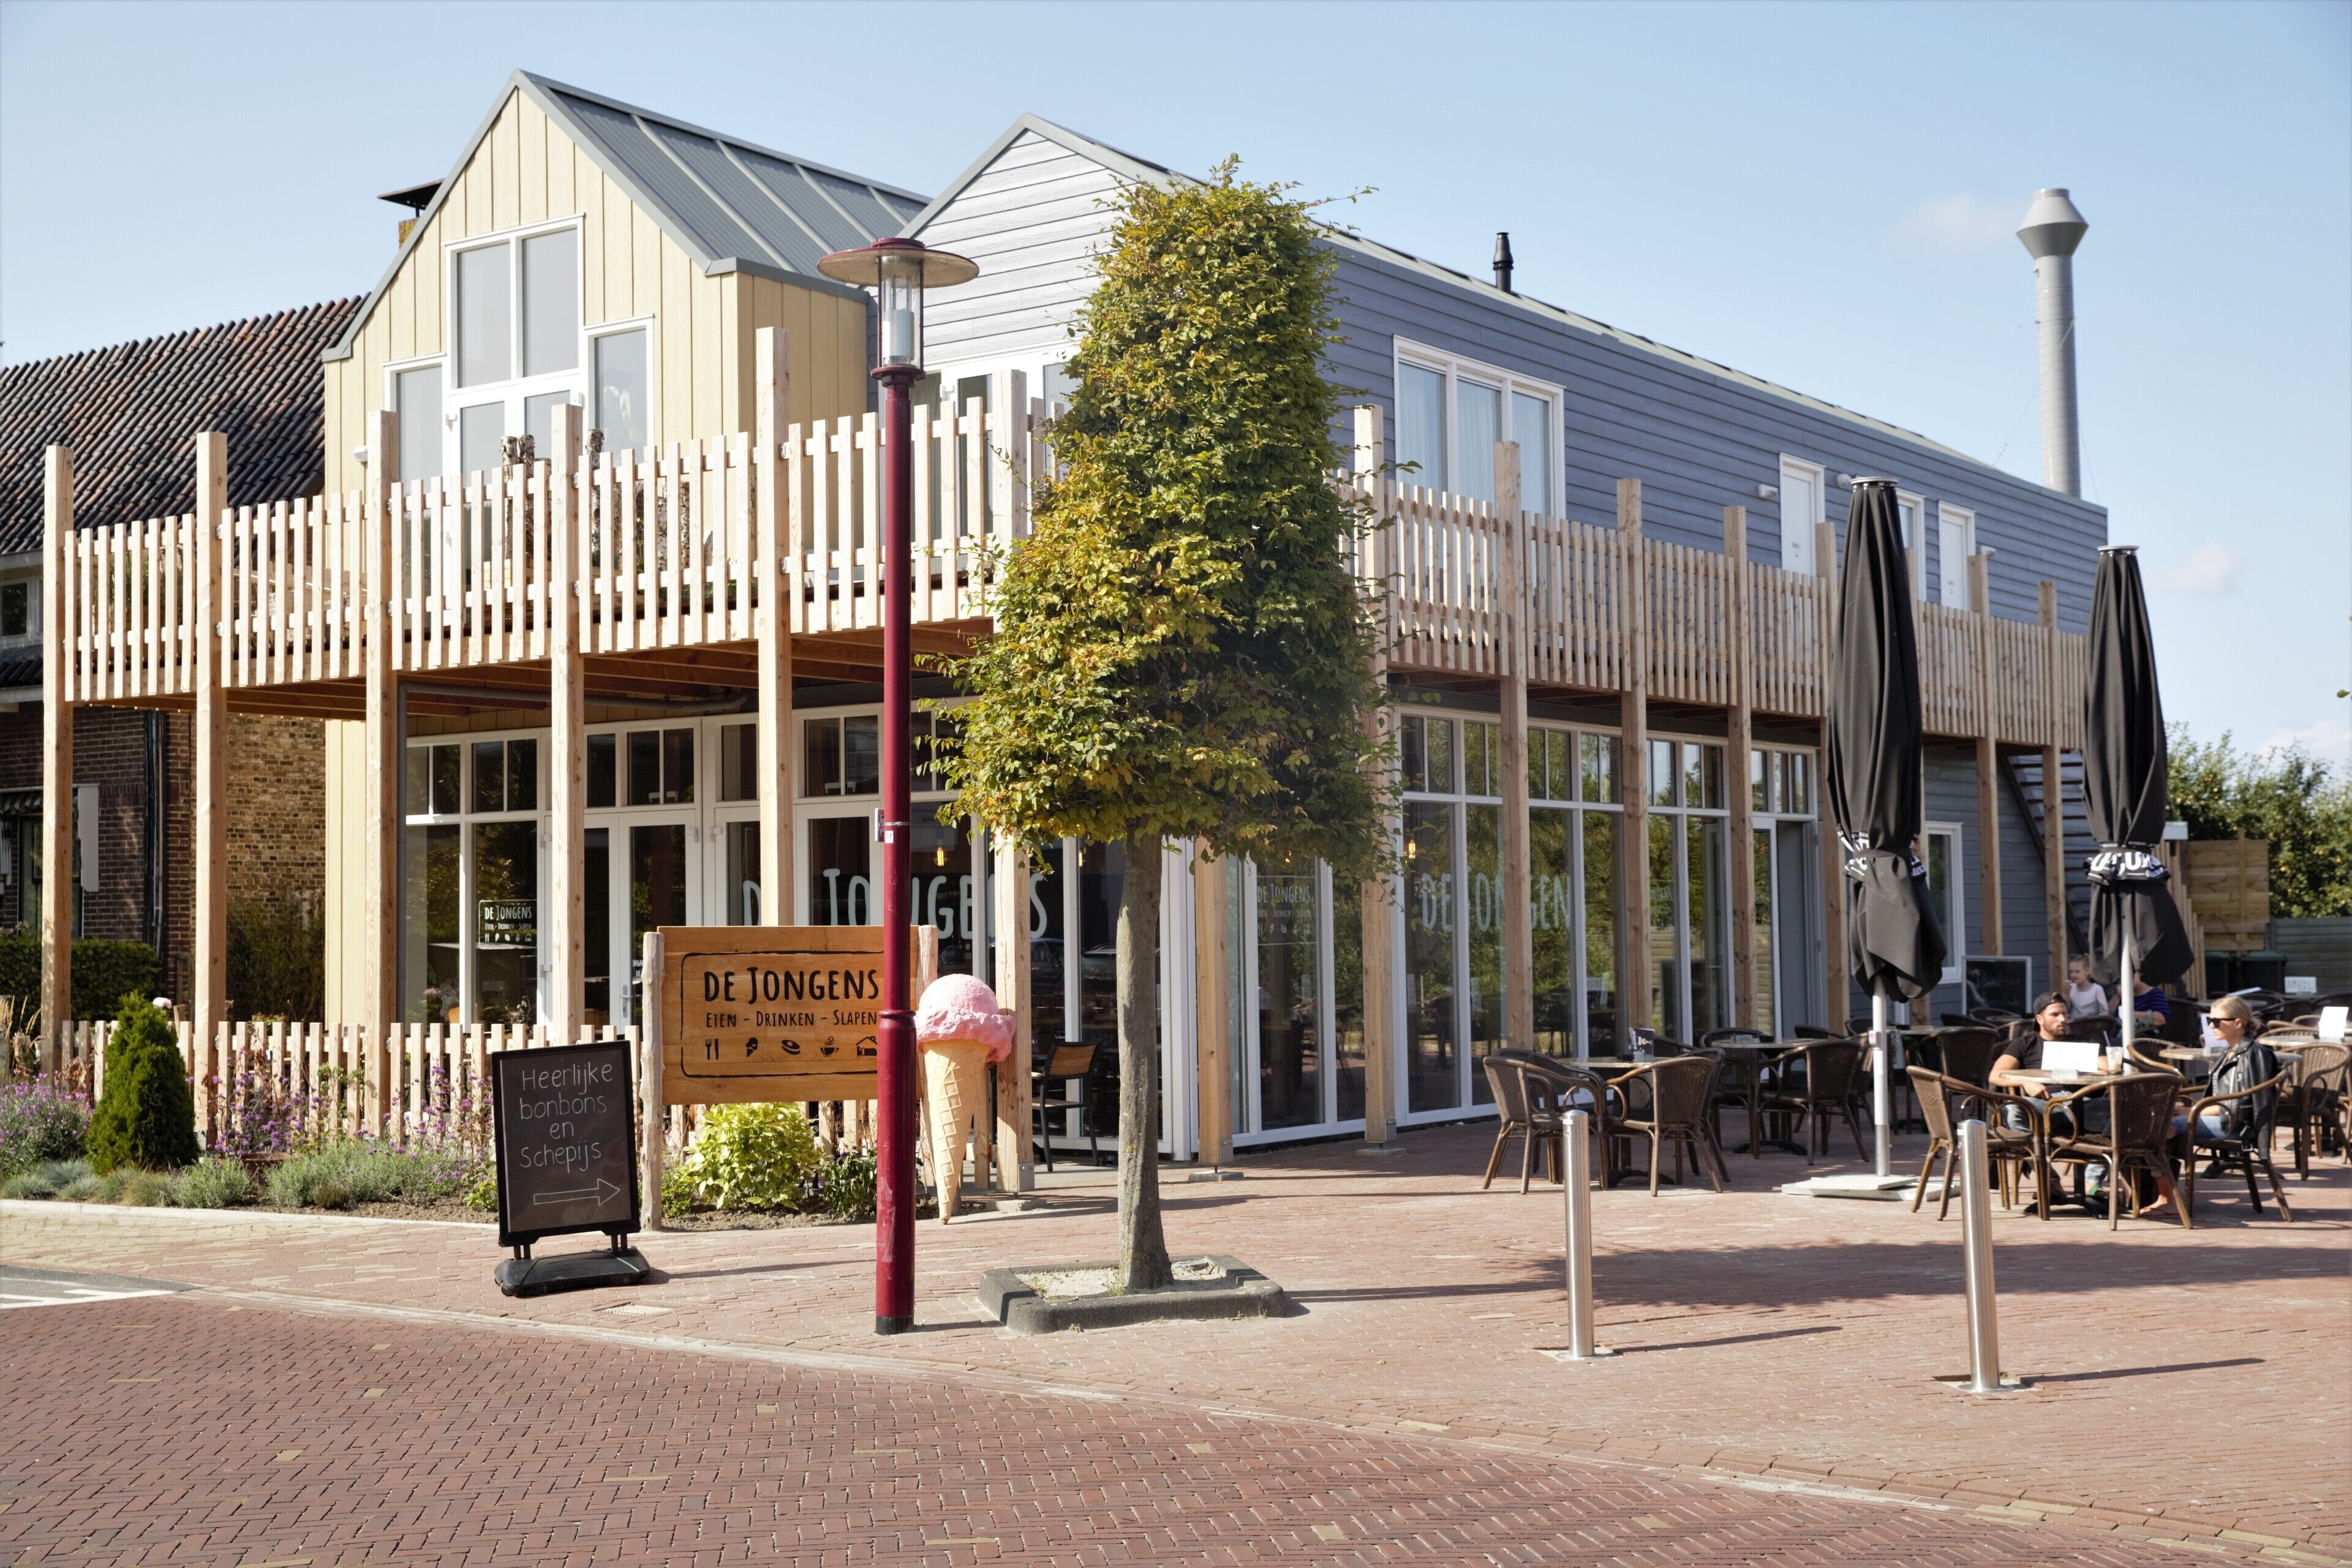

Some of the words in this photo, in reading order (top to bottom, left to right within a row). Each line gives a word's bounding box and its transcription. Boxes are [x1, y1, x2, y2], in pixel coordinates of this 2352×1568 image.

[1257, 886, 1268, 903] DE
[484, 907, 494, 920] DE
[496, 905, 532, 921] JONGENS
[704, 971, 735, 1001] DE
[747, 967, 879, 1005] JONGENS
[706, 1012, 736, 1028] ETEN
[756, 1011, 814, 1027] DRINKEN
[834, 1010, 876, 1026] SLAPEN
[522, 1061, 612, 1095] Heerlijke
[520, 1092, 607, 1120] bonbons
[550, 1121, 574, 1139] en
[520, 1140, 601, 1174] Schepijs
